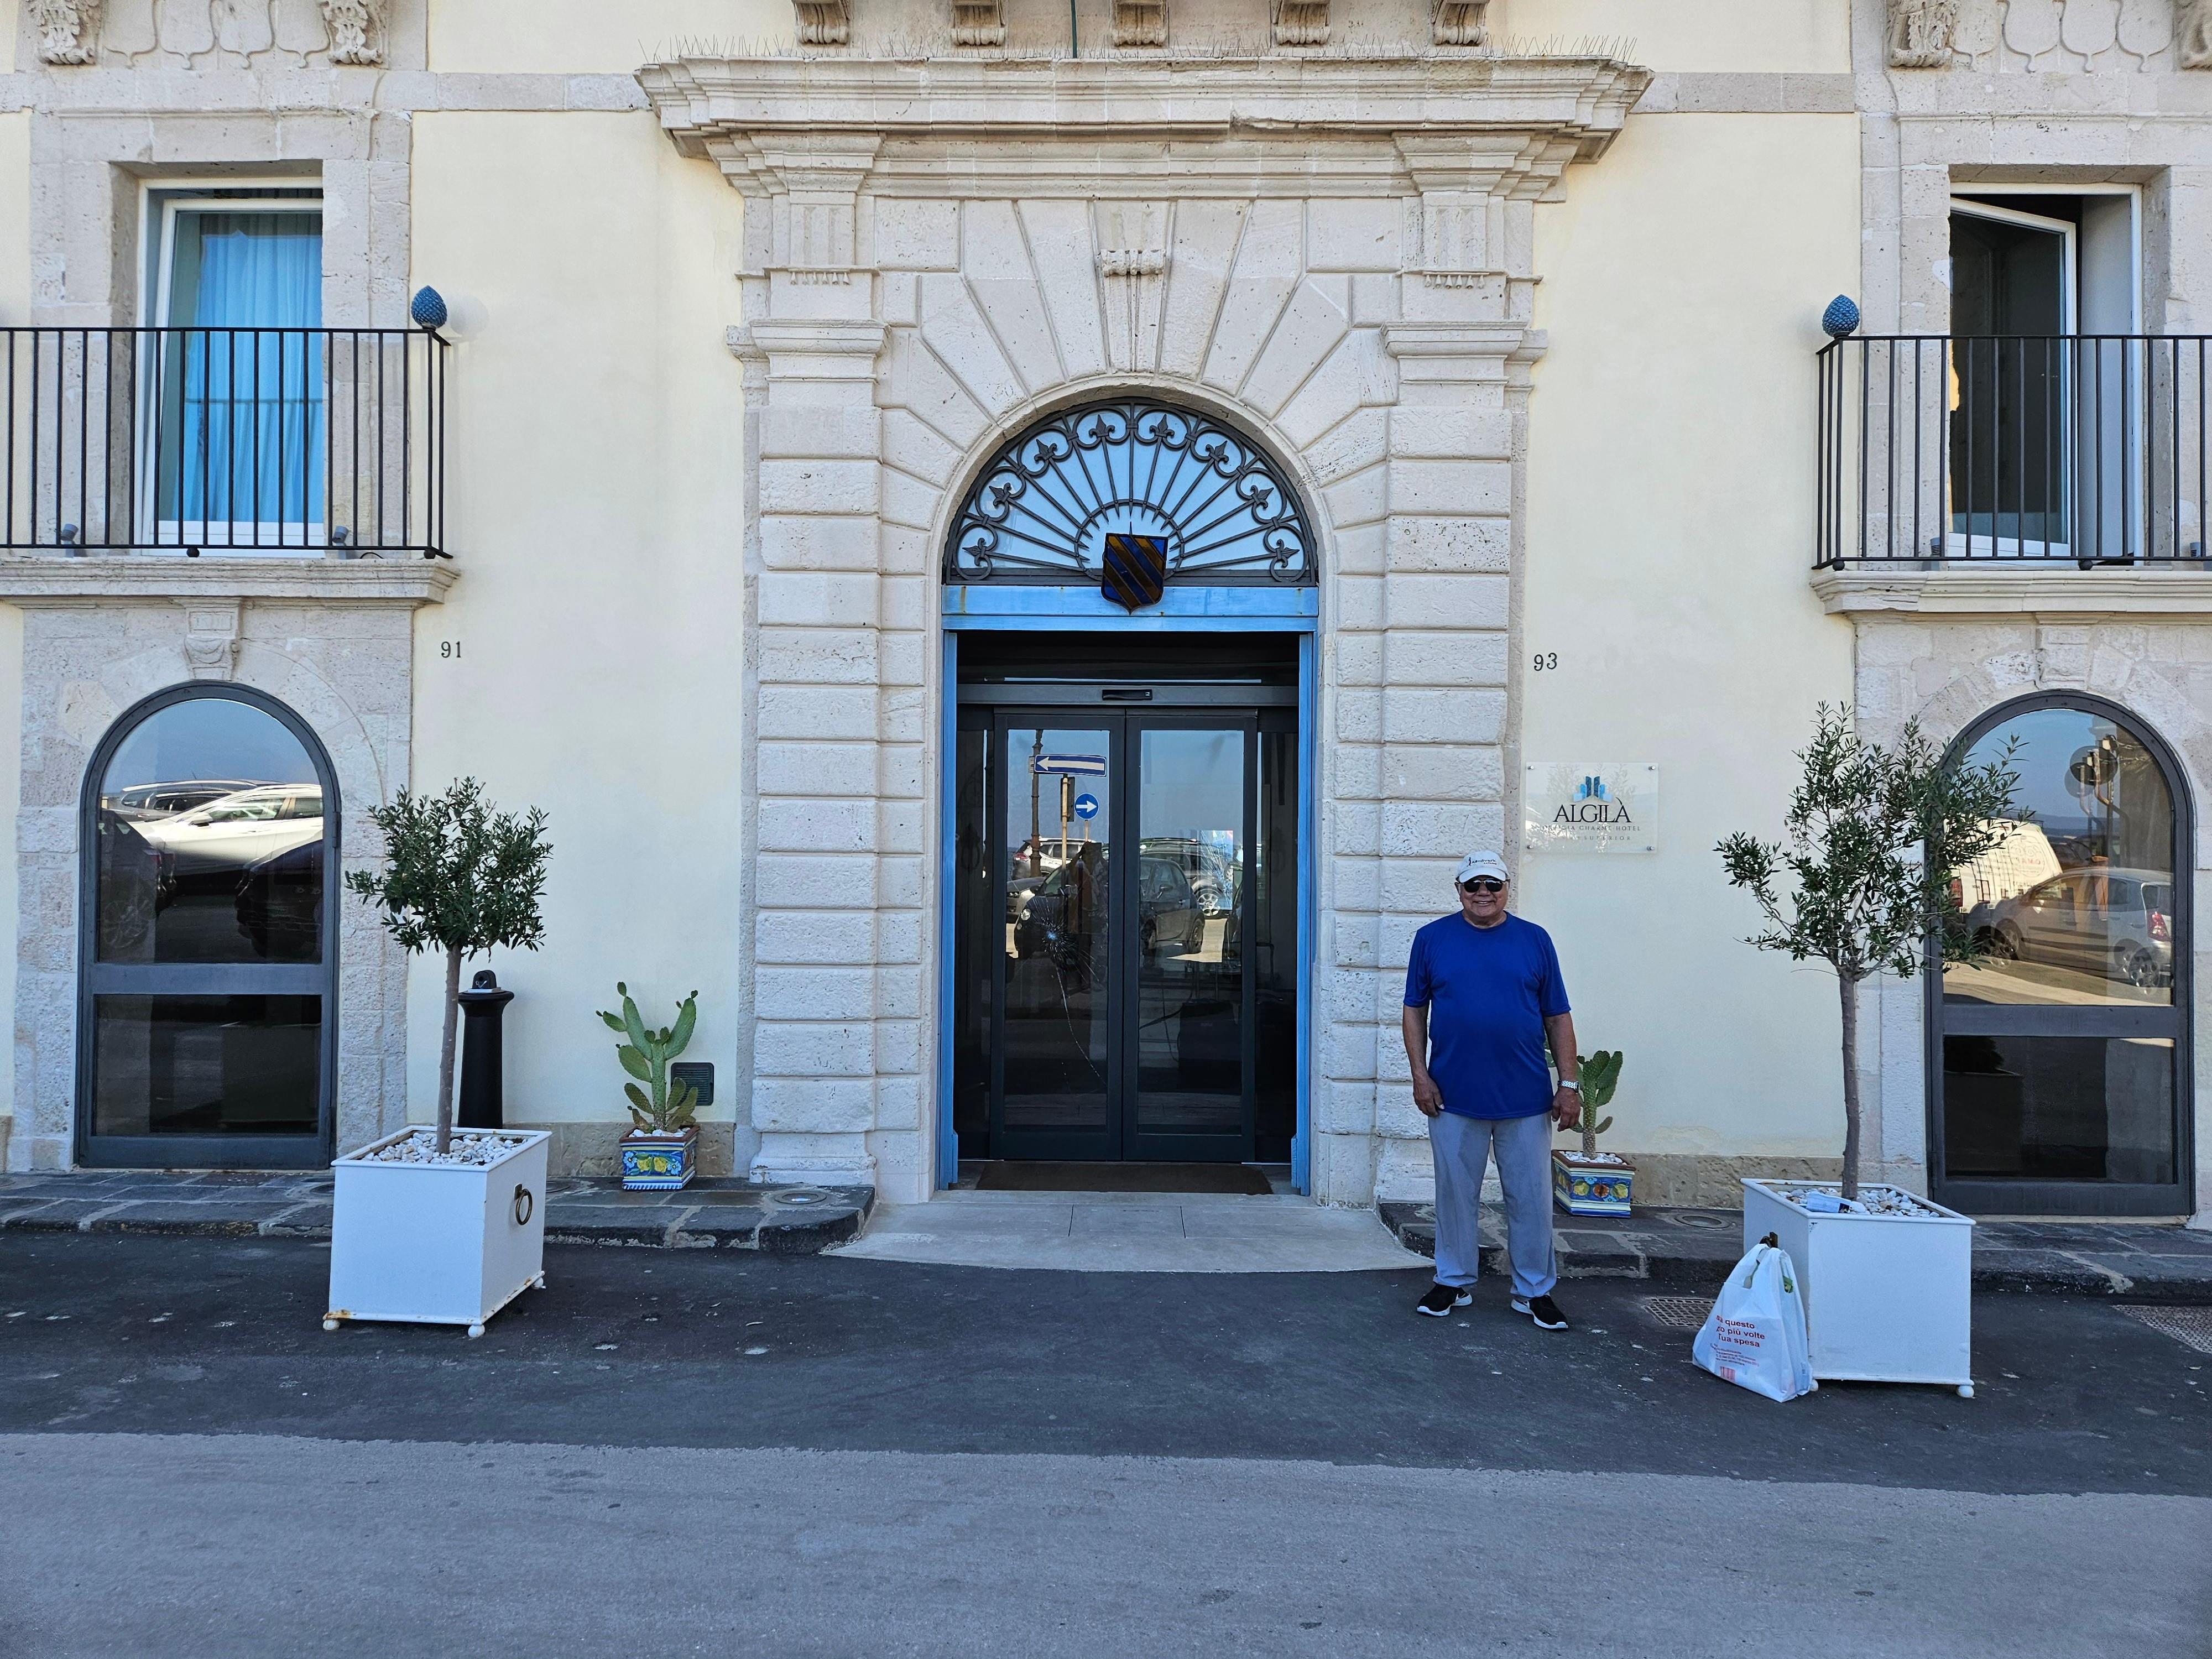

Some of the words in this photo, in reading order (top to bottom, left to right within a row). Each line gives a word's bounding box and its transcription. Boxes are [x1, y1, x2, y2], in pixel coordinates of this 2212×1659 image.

[441, 641, 461, 658] 91
[1533, 652, 1557, 671] 93
[1552, 796, 1632, 823] ALGILÀ
[1725, 1319, 1755, 1329] questo
[1734, 1338, 1760, 1347] spesa
